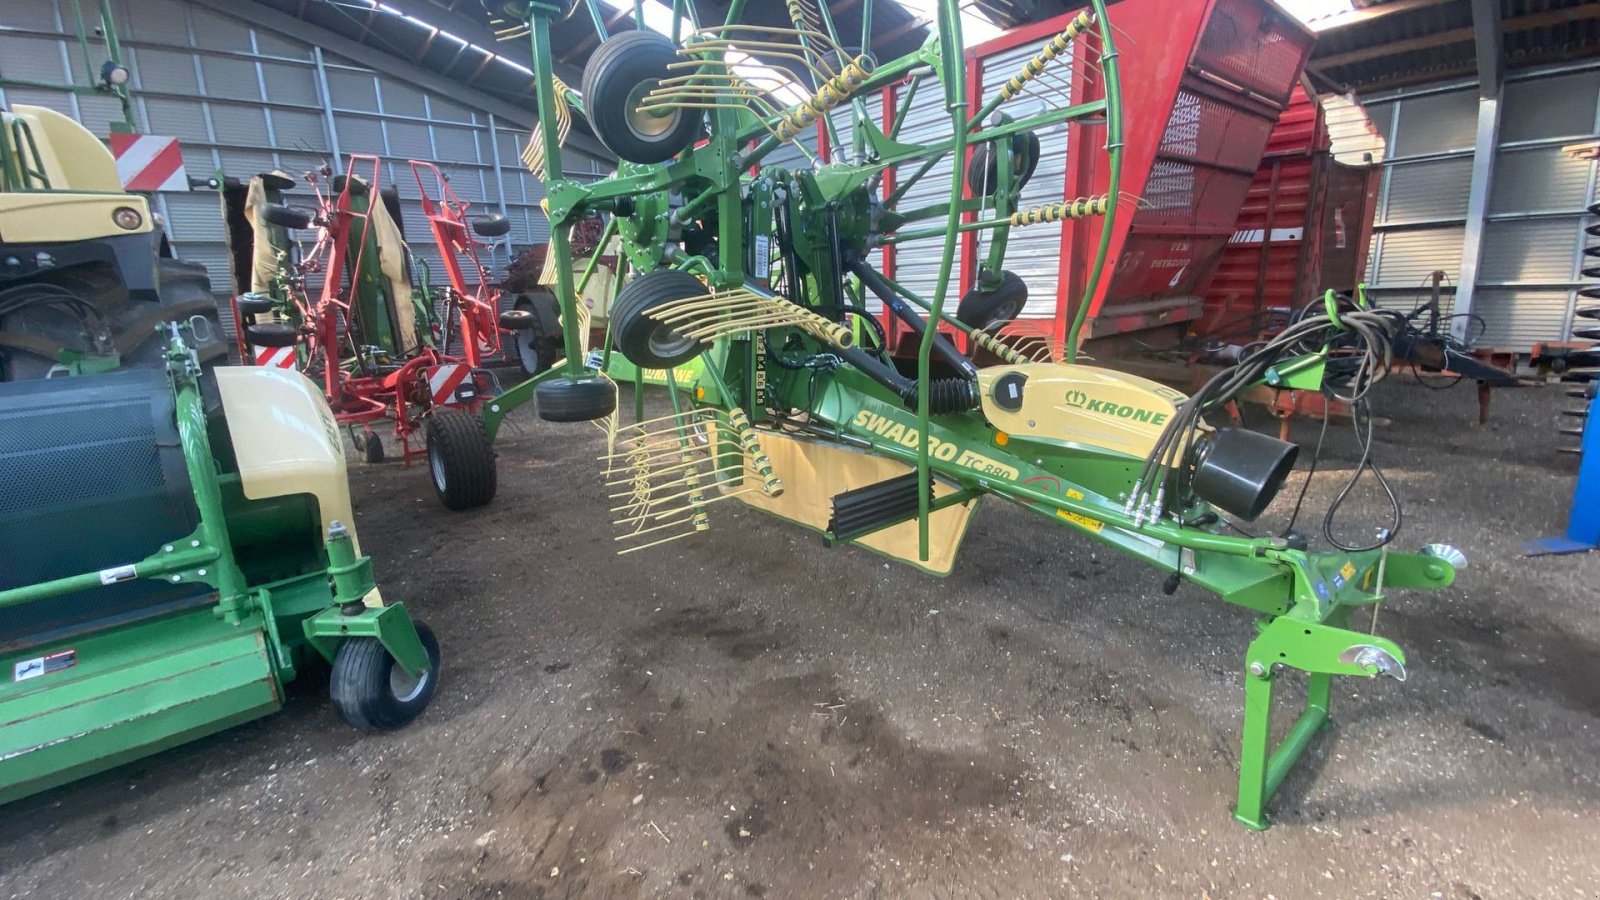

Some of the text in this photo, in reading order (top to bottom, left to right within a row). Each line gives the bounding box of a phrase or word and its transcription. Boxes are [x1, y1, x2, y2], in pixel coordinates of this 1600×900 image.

[1086, 399, 1168, 426] KRONE
[965, 455, 982, 469] TC
[984, 464, 1011, 479] 880
